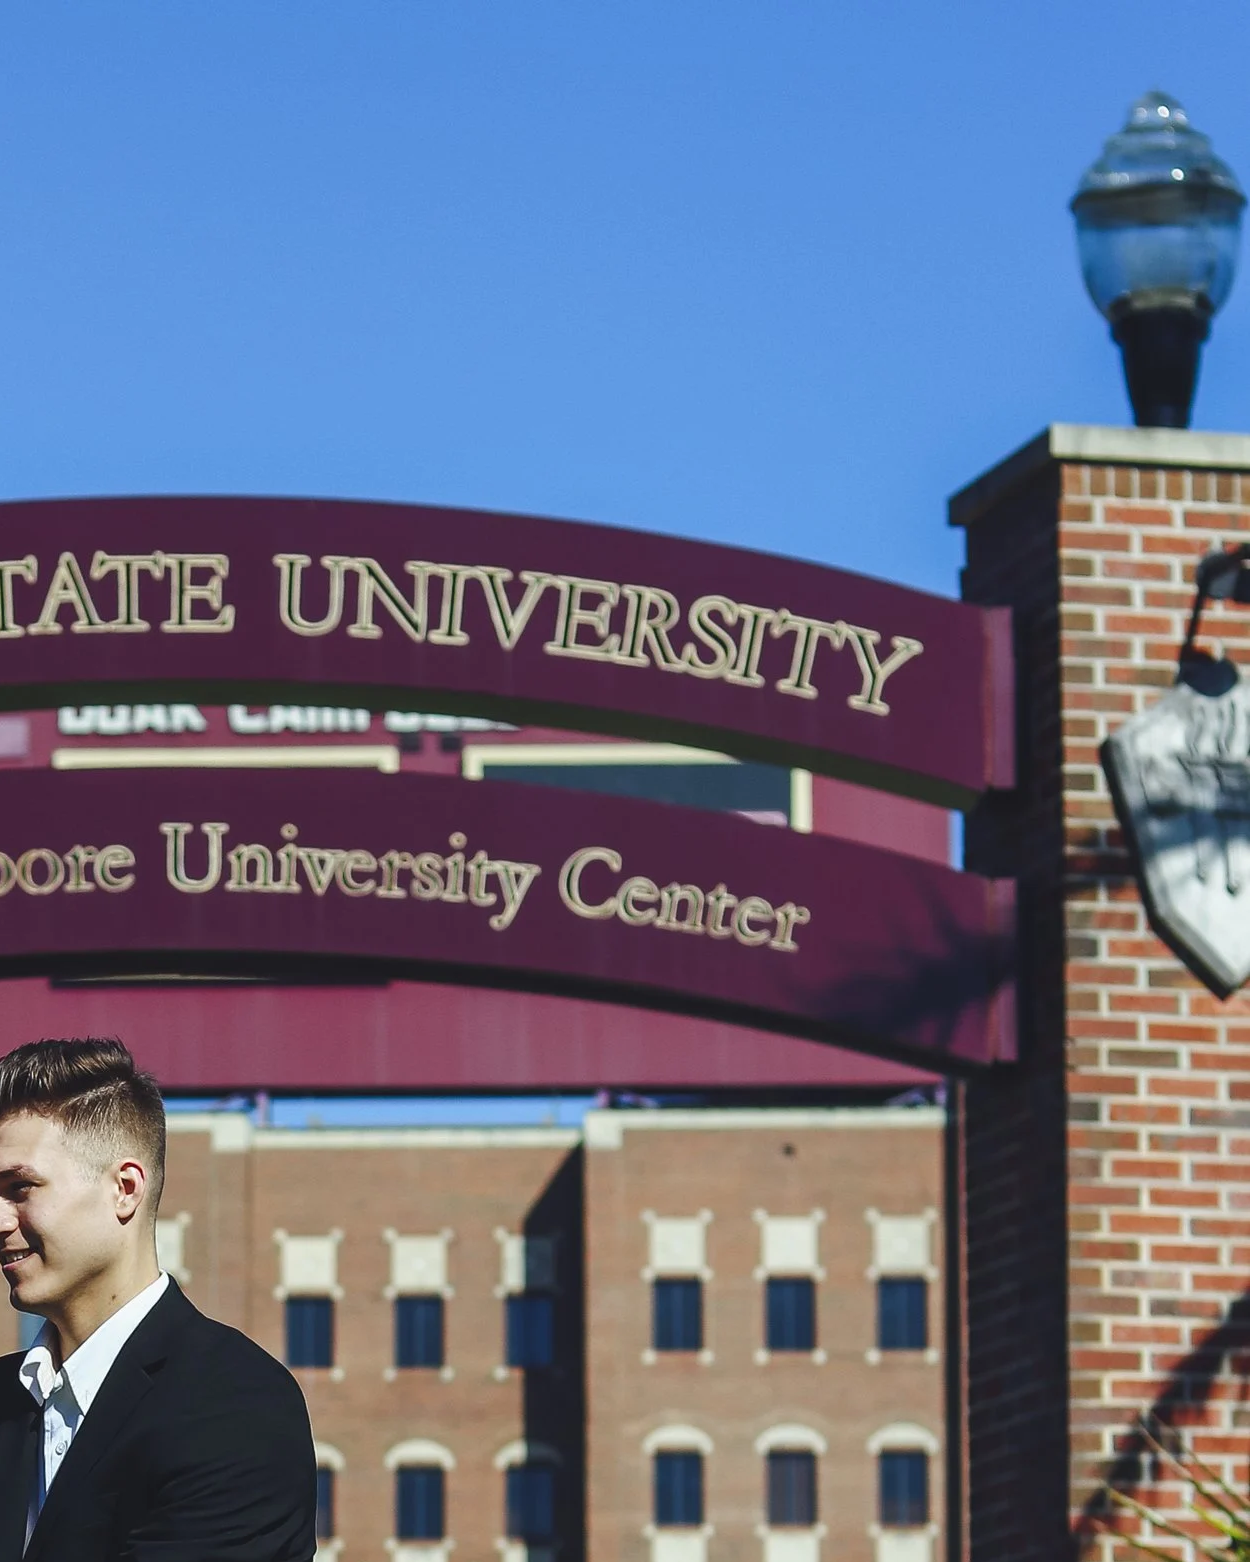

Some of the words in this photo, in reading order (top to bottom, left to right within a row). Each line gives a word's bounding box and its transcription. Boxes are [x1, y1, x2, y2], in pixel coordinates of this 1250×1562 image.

[273, 553, 924, 716] UNIVERSITY
[160, 822, 542, 931] University
[558, 846, 811, 953] Center
